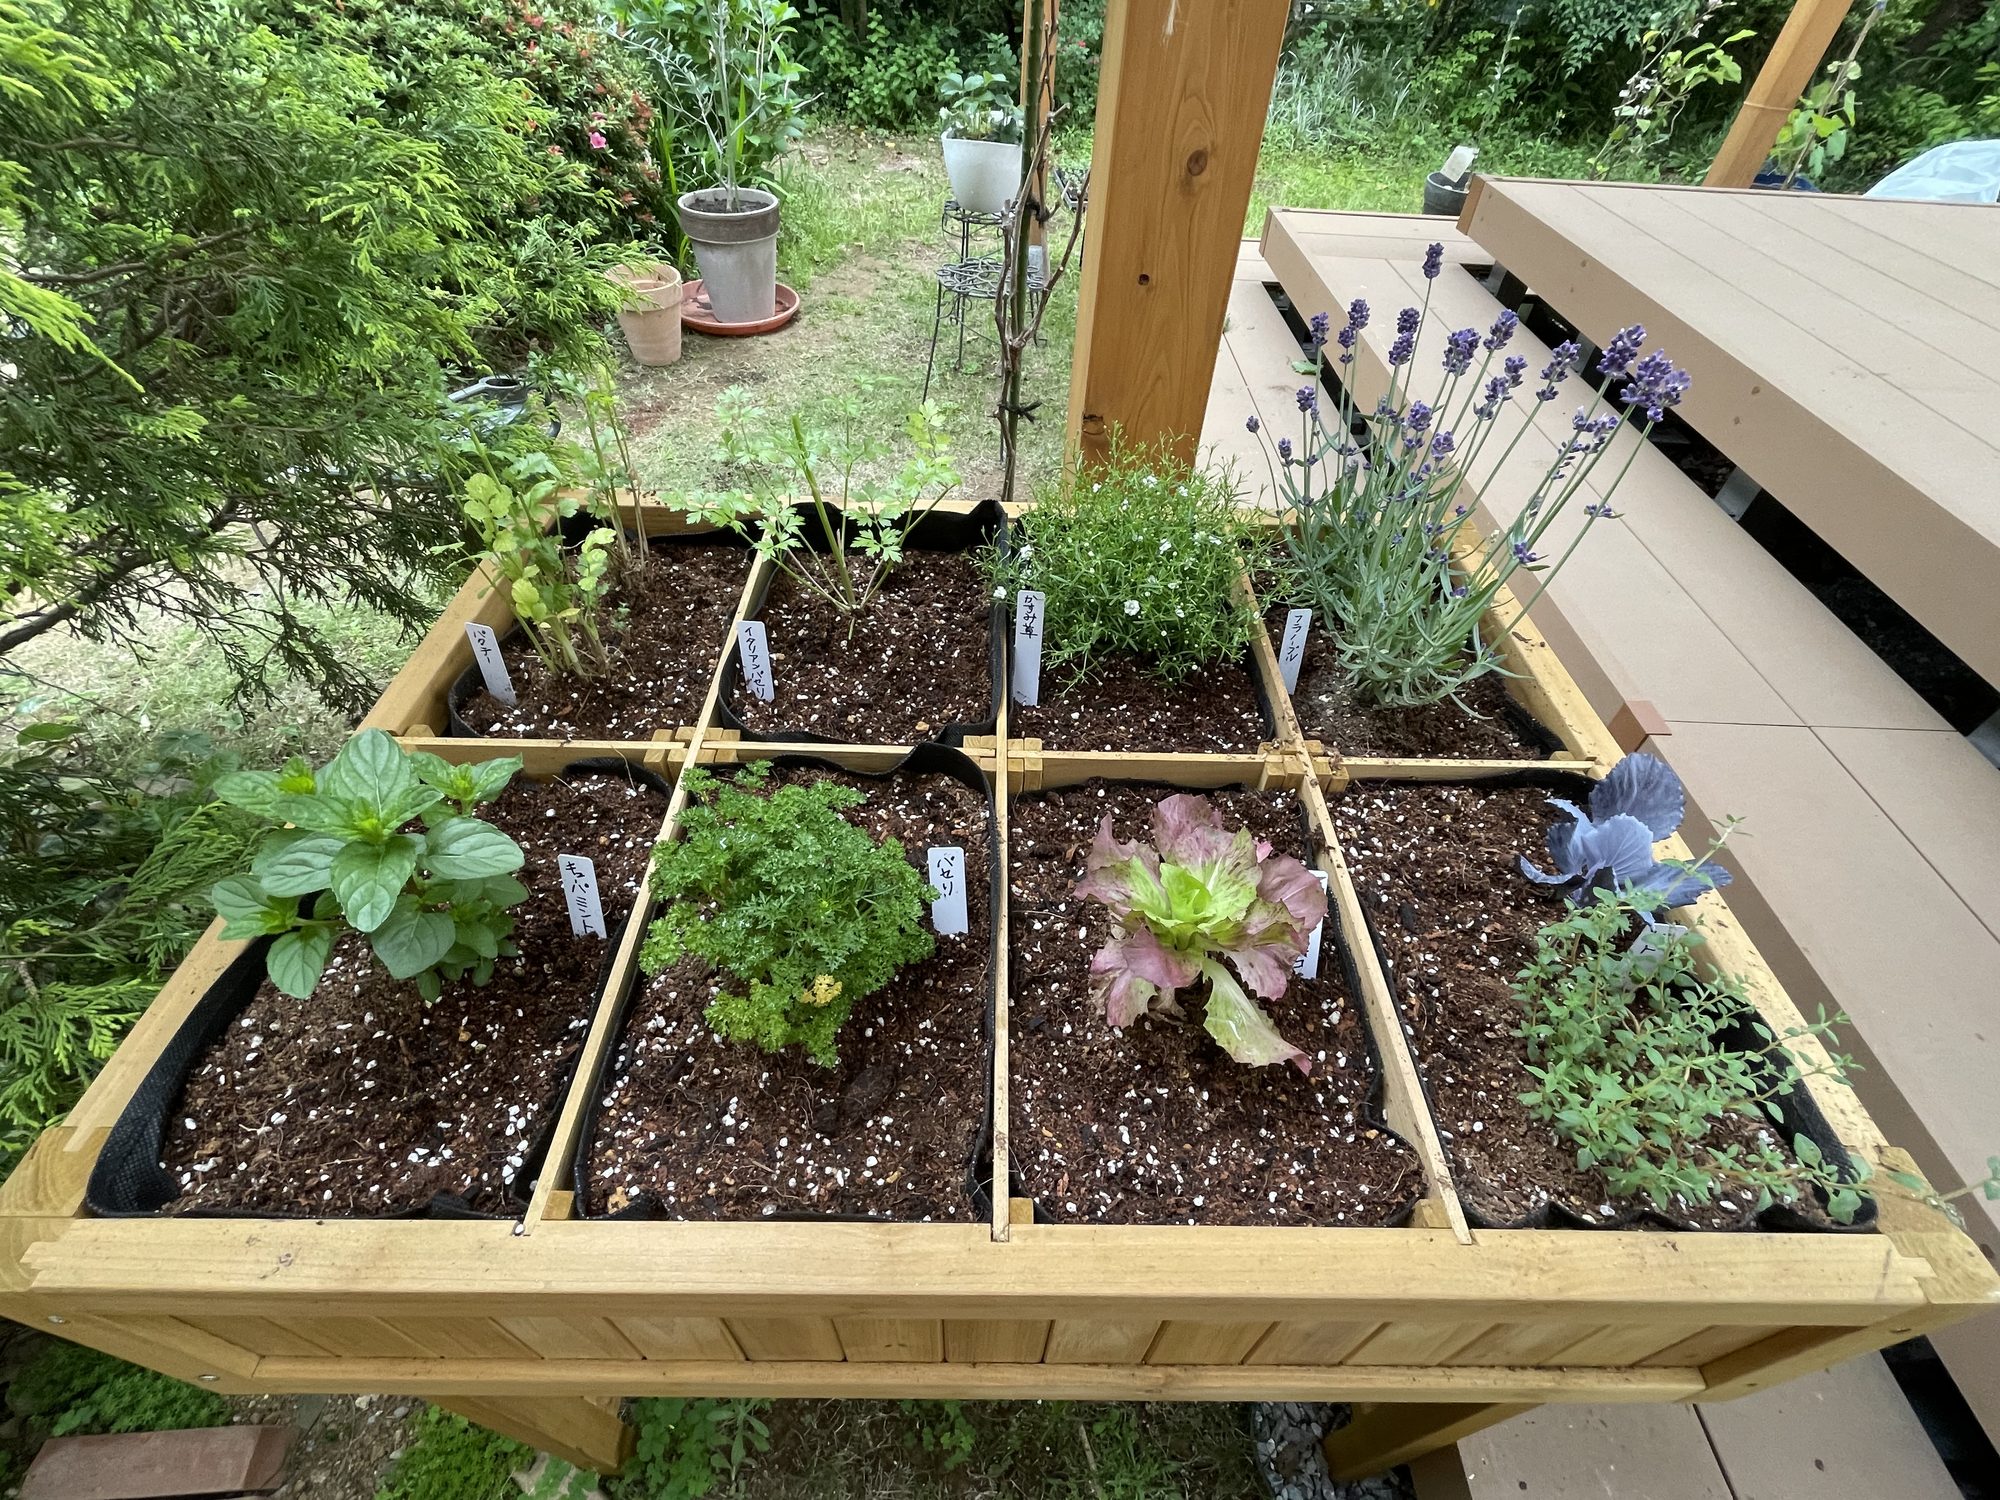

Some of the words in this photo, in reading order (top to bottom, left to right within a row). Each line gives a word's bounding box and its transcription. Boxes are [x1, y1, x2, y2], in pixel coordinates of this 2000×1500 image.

[473, 630, 492, 664] パクチー
[744, 626, 766, 699] イタリアンパセリ
[936, 855, 955, 898] パセリ
